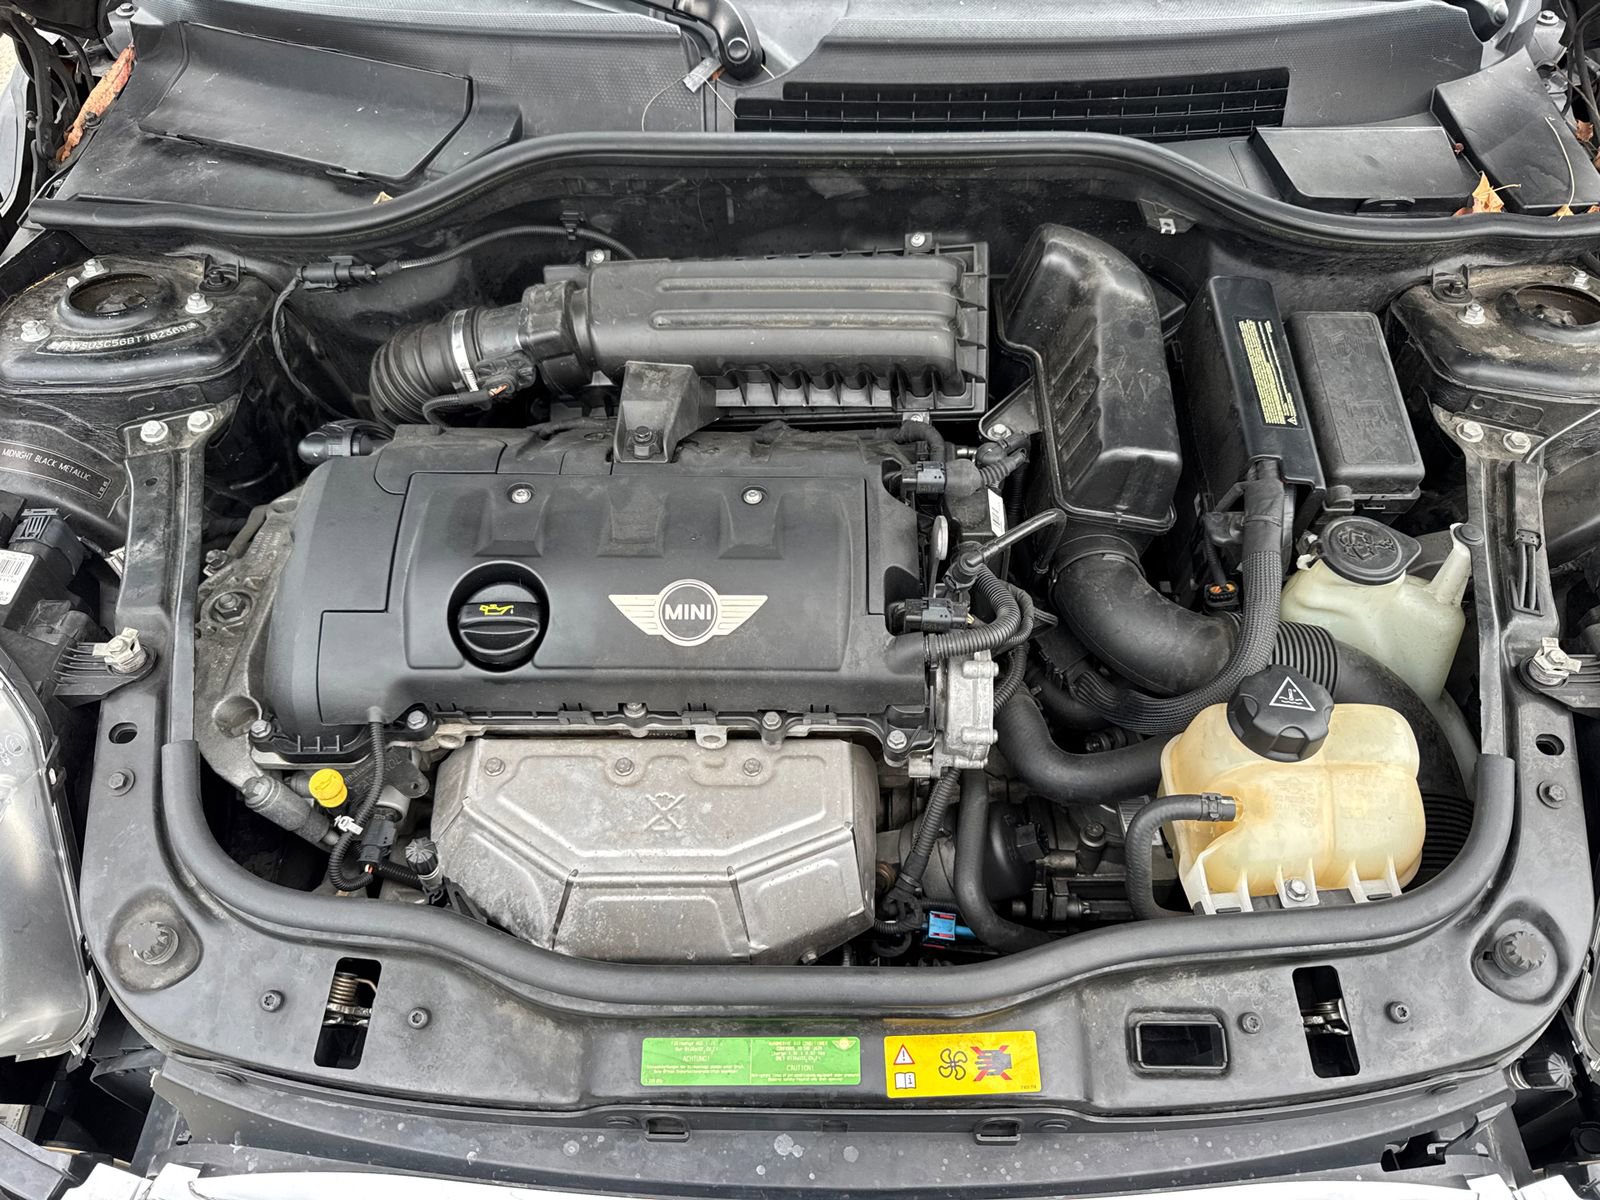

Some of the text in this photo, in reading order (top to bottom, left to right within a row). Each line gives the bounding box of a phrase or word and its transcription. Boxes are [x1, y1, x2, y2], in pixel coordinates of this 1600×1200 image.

[2, 448, 91, 481] MIDNIGHT BLACK METALLIC
[664, 603, 712, 621] MINI
